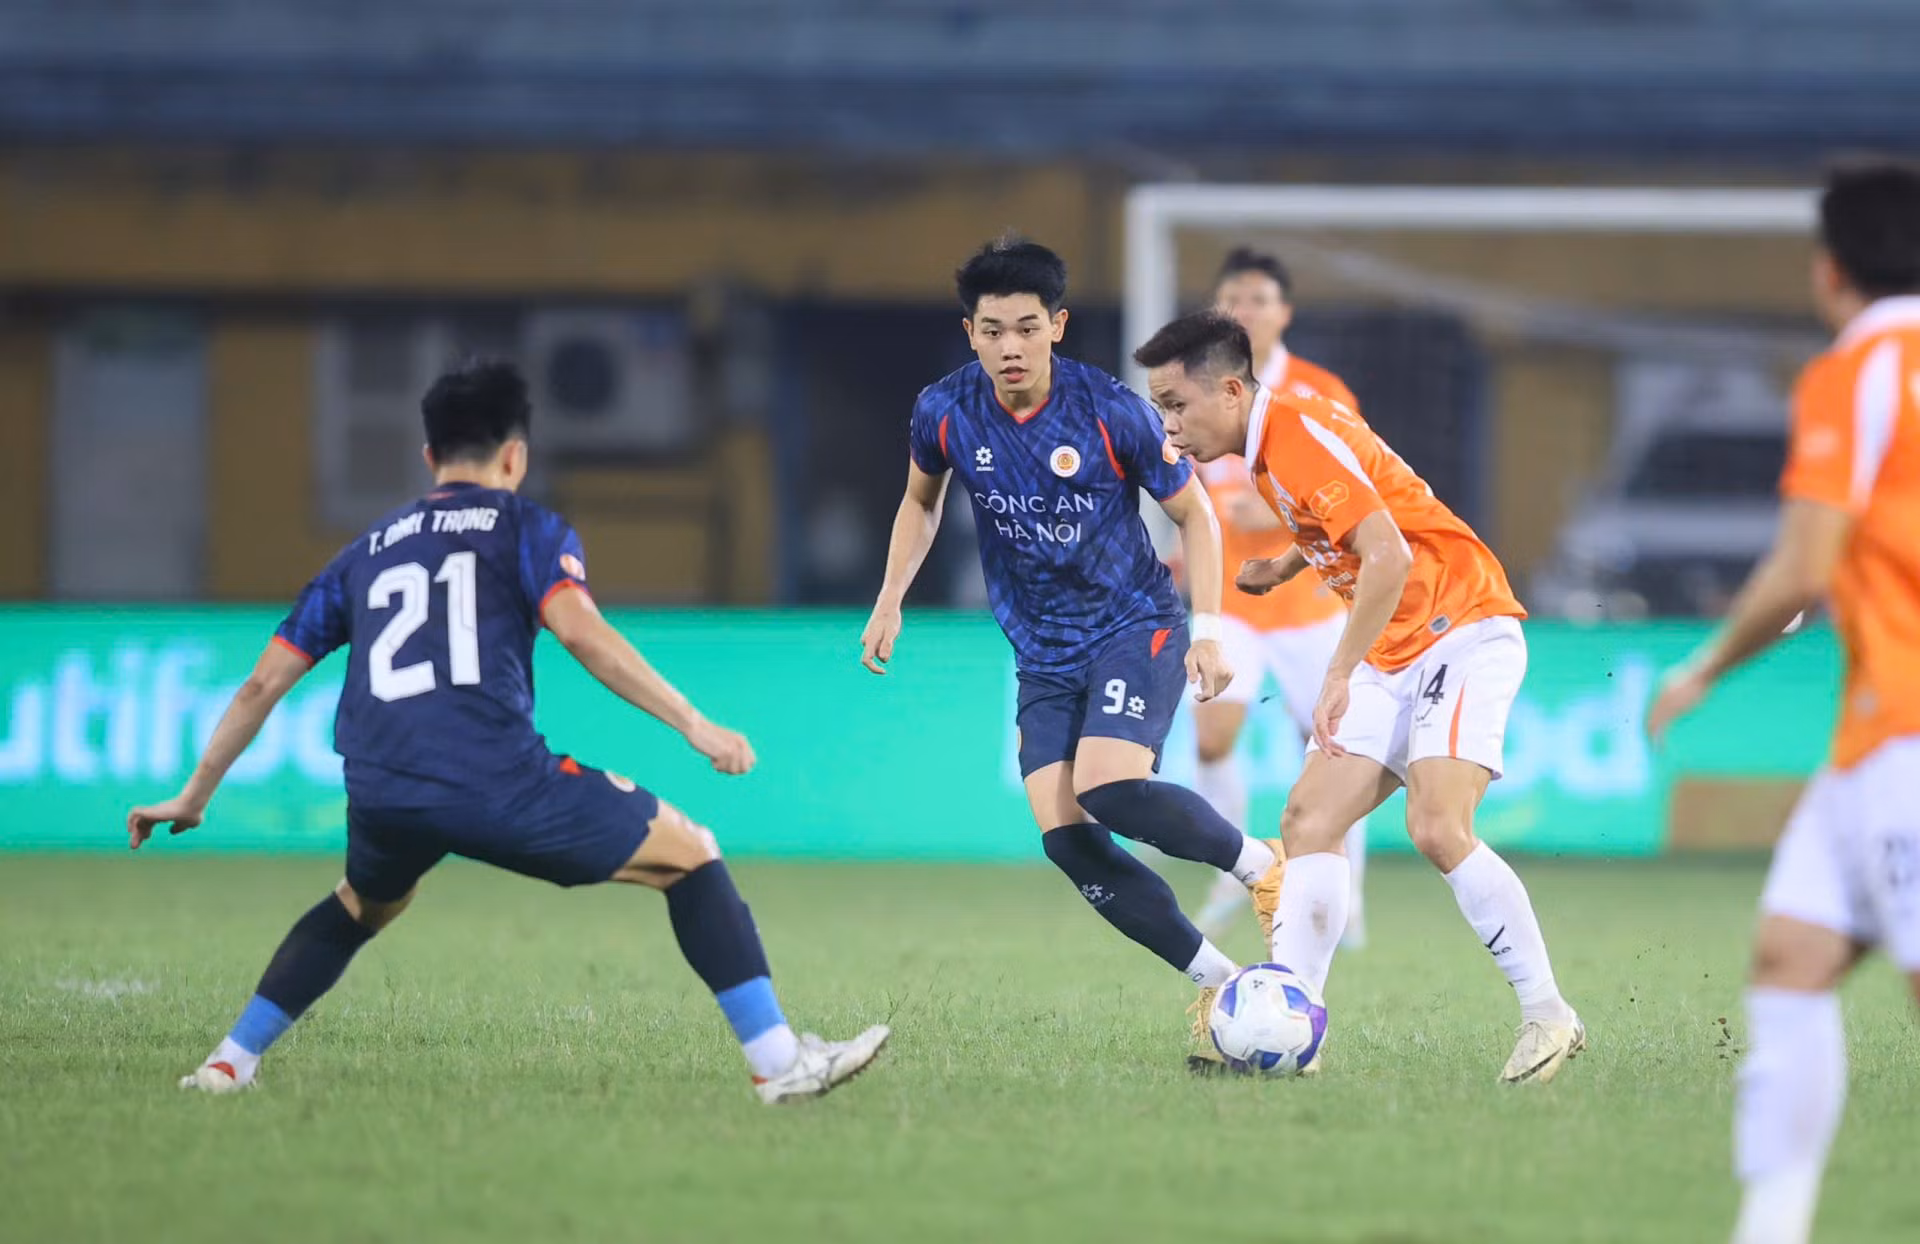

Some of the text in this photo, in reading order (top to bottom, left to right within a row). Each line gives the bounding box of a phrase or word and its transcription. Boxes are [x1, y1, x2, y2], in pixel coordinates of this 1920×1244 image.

[974, 489, 1094, 514] CÔNG AN
[995, 518, 1081, 547] HÀ NỘI
[367, 551, 481, 702] 21
[1102, 678, 1127, 714] 9
